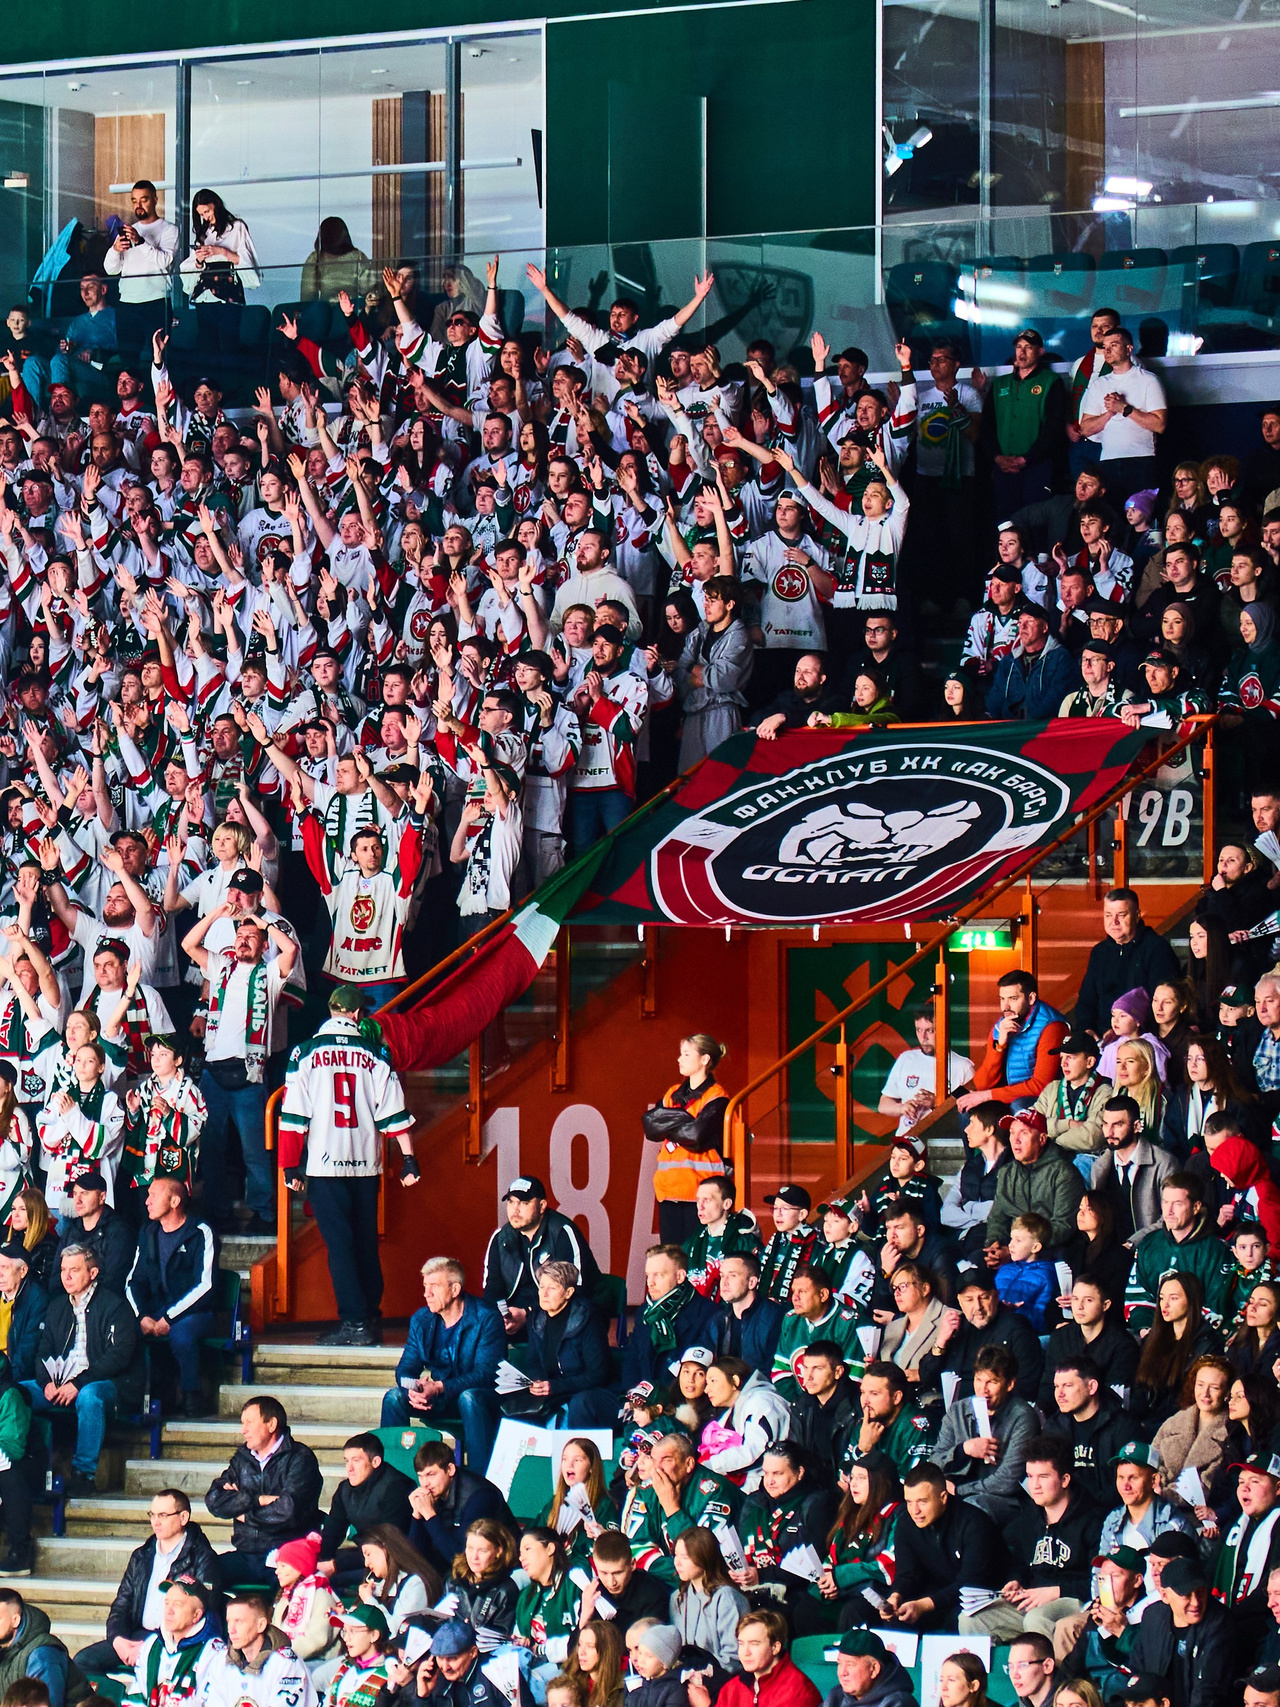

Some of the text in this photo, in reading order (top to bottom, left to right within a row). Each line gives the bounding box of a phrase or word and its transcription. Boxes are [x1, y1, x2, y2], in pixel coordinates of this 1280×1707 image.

[773, 629, 813, 637] TATNEFT
[574, 766, 610, 777] ATNEFT
[733, 756, 1048, 820] ФАН-КЛУБ ХК «АК БАРС»
[742, 865, 918, 885] ОСКАЛ
[339, 964, 389, 976] TATNEFT
[251, 965, 268, 1032] АЗАНЬ
[334, 1072, 359, 1129] 9
[332, 1160, 368, 1168] TATNEFT
